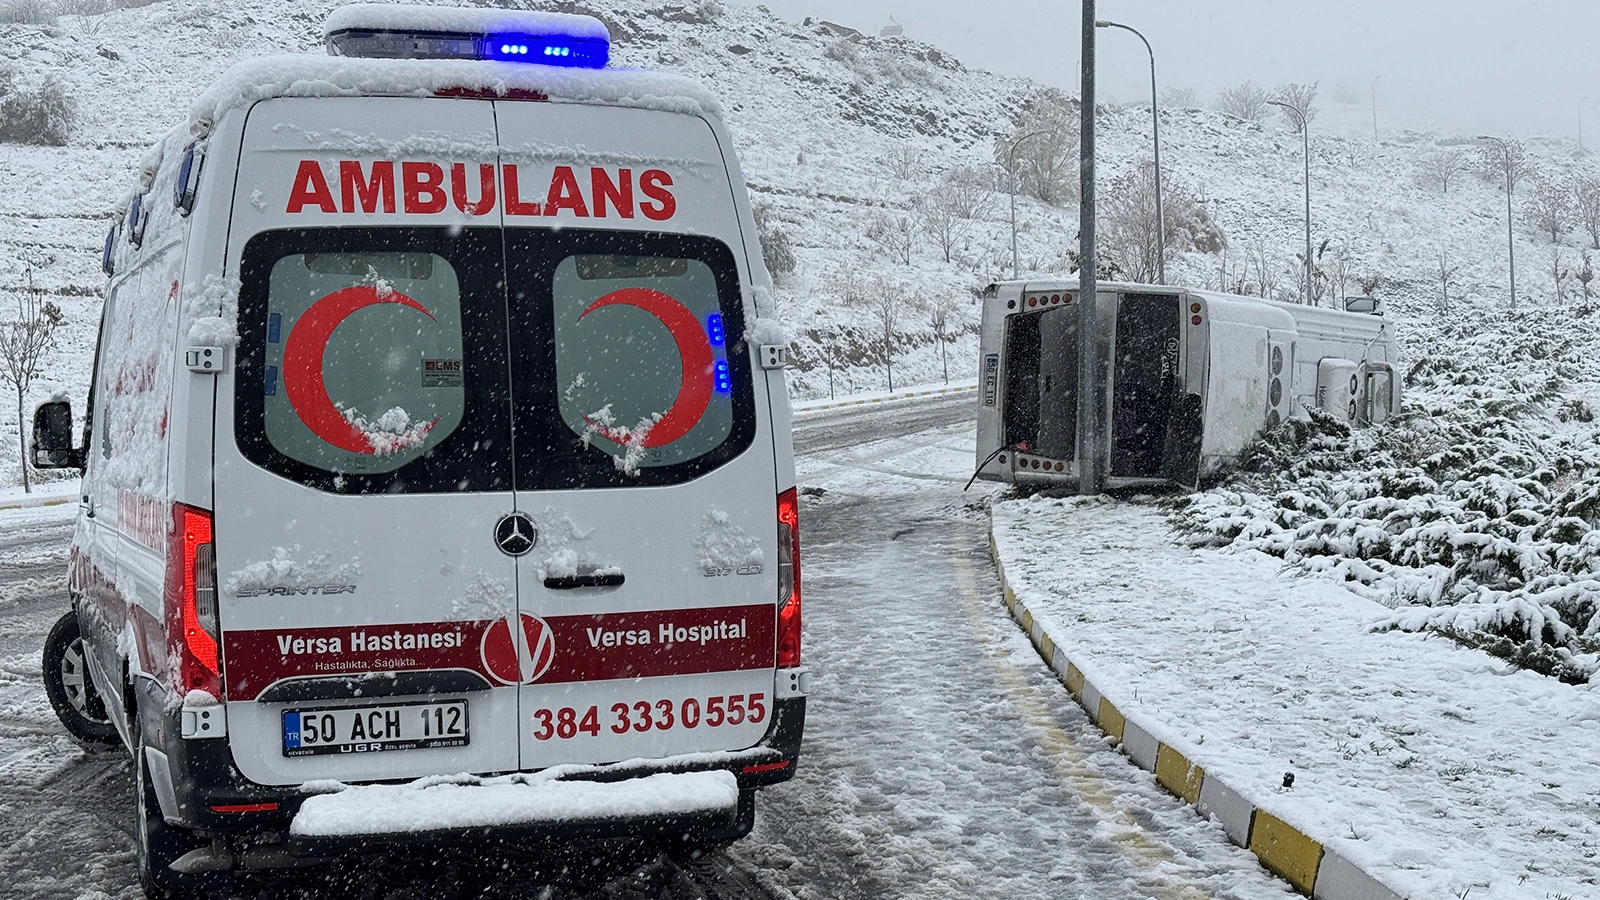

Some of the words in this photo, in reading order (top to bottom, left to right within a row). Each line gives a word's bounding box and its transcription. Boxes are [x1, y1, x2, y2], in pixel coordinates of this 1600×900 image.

[286, 160, 677, 220] AMBULANS
[436, 361, 460, 371] EMS
[236, 584, 356, 598] SPRINTER
[277, 635, 342, 655] Versa
[351, 627, 462, 651] Hastanesi
[587, 627, 650, 647] Versa
[660, 619, 746, 645] Hospital
[287, 732, 300, 741] TR
[303, 714, 336, 743] 50
[351, 711, 400, 740] ACH
[421, 706, 462, 736] 112
[533, 706, 600, 741] 384
[340, 743, 382, 753] UGR
